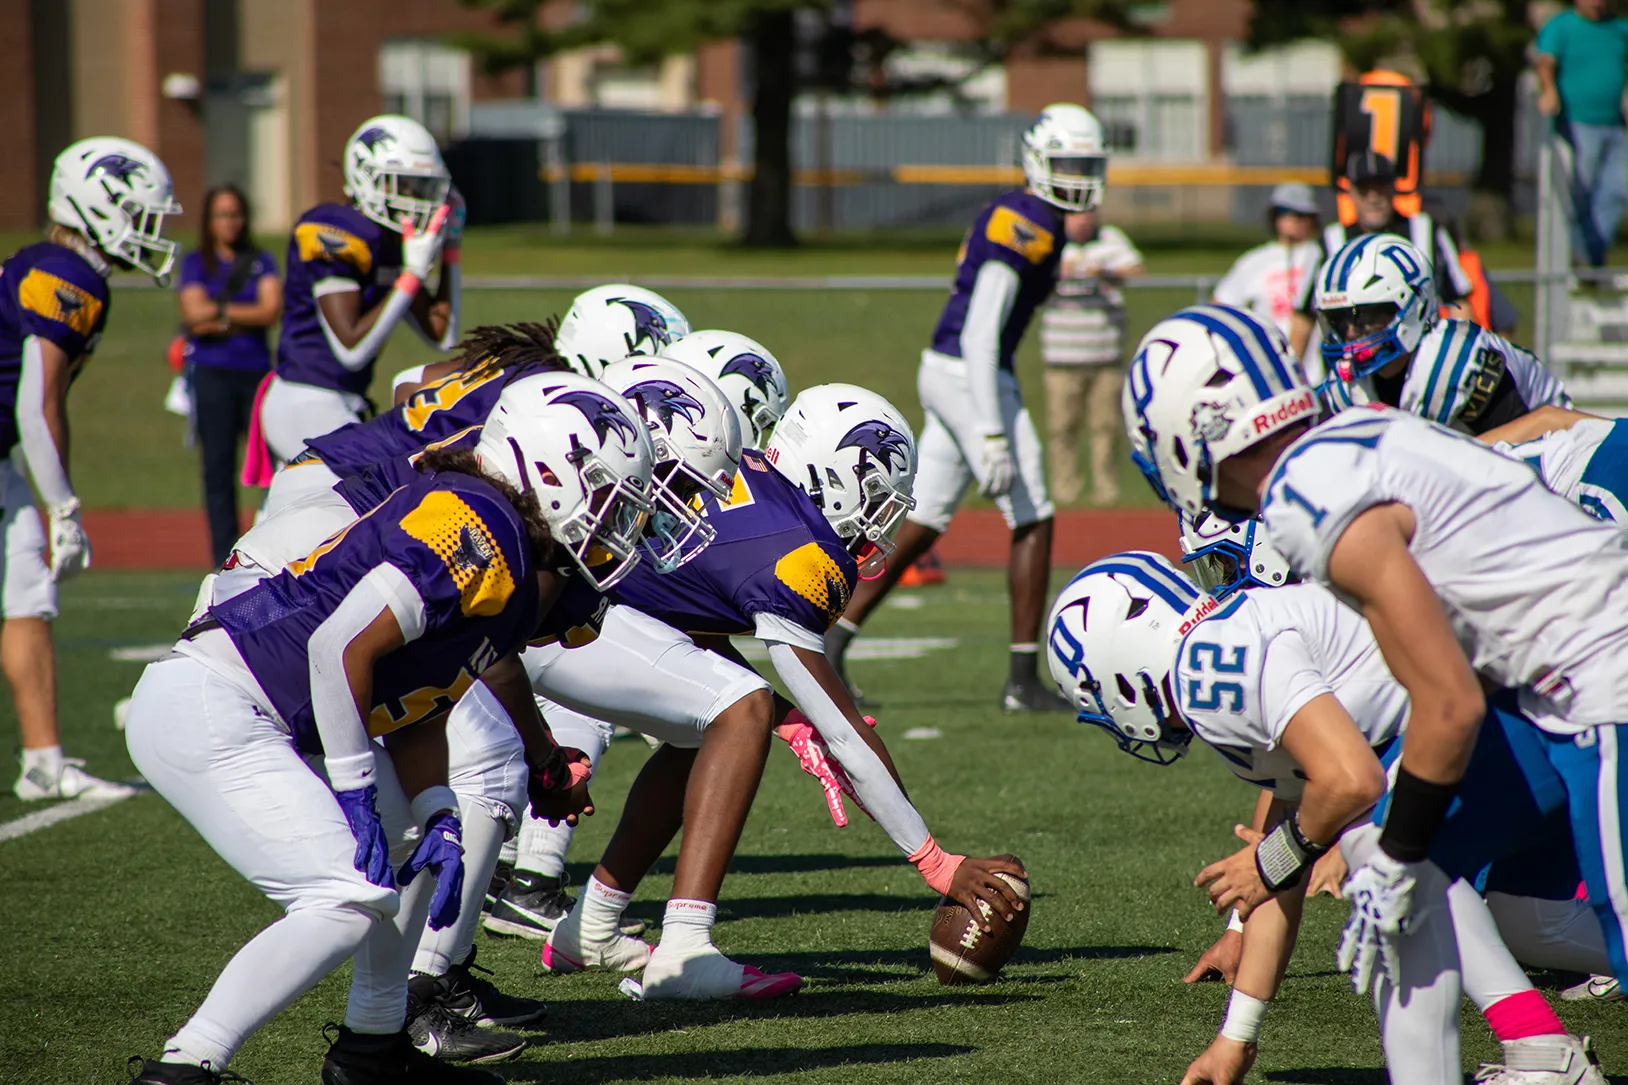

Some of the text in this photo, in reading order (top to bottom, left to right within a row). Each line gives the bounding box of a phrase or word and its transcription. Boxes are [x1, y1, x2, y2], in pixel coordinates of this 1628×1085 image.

[1360, 87, 1400, 163] 1
[1283, 483, 1329, 530] 1
[1188, 641, 1249, 715] 52
[667, 900, 708, 912] Supreme
